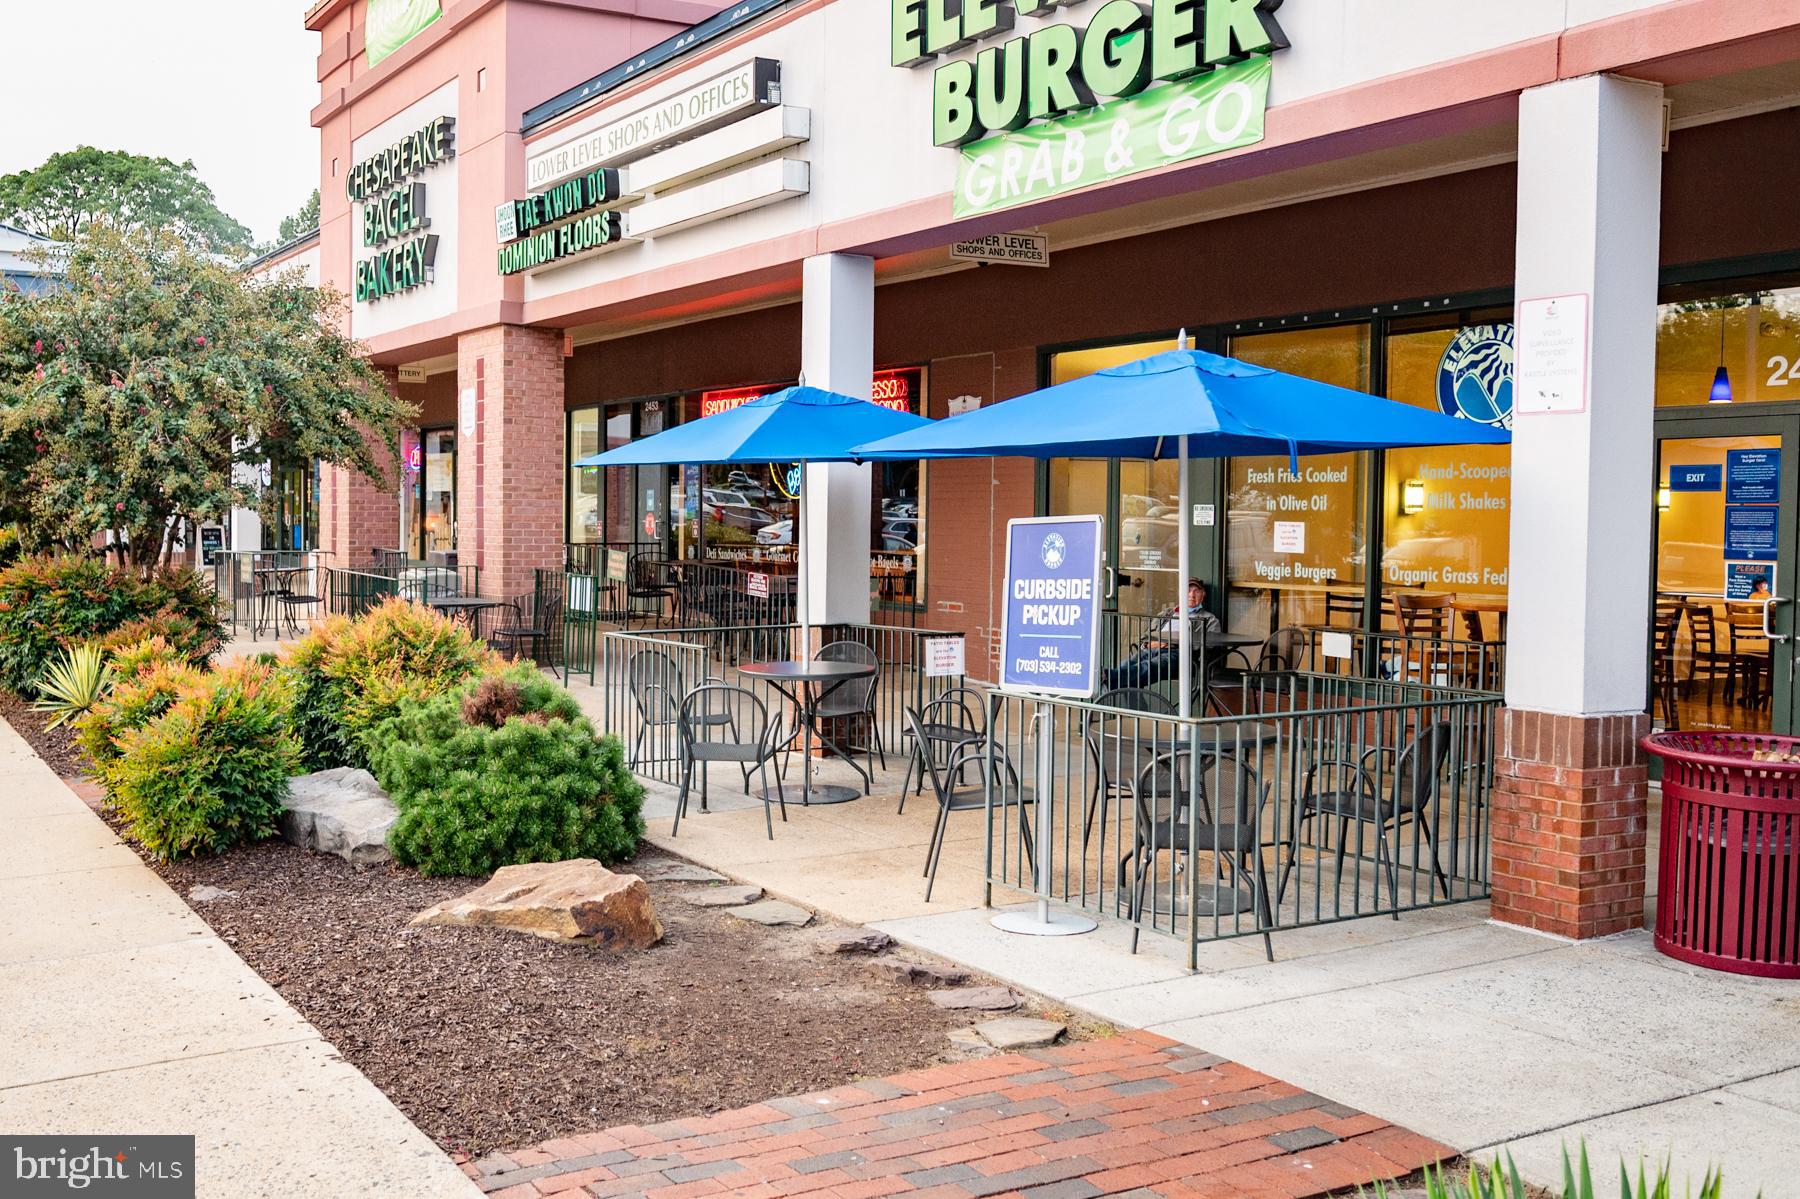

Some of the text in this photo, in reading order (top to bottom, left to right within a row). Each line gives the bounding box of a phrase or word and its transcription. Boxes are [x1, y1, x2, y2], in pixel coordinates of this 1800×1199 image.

[933, 0, 1275, 147] BURGER
[532, 151, 569, 182] LOWER
[572, 136, 604, 167] LEVEL
[608, 116, 650, 155] SHOPS
[653, 102, 683, 136] AND
[688, 72, 749, 119] OFFICES
[964, 81, 1253, 207] GRAB & GO
[346, 116, 451, 203] CHESAPEAKE
[517, 168, 606, 231] TAE KWON DO
[364, 182, 425, 247] BAGEL
[498, 210, 610, 276] DOMINION FLOORS
[956, 244, 1042, 260] SHOPS AND OFFICES
[961, 235, 1038, 250] OWER LEVEL
[357, 234, 433, 303] BAKERY
[1442, 323, 1514, 373] ELEVATI
[1247, 465, 1348, 483] Fresh Fries Cooked
[1686, 473, 1706, 483] EXIT
[1266, 494, 1328, 511] in Olive Oil
[1427, 491, 1506, 510] Milk Shakes
[706, 547, 717, 559] Deli
[877, 554, 899, 572] Bagels
[1255, 560, 1337, 582] Veggie Burgers
[1389, 565, 1508, 586] Organic Grass Fed
[1735, 565, 1766, 573] PLEASE
[1014, 578, 1092, 600] CURBSIDE
[1022, 604, 1081, 626] PICKUP
[1039, 646, 1060, 658] CALL
[1016, 659, 1082, 675] (703) 534-2302
